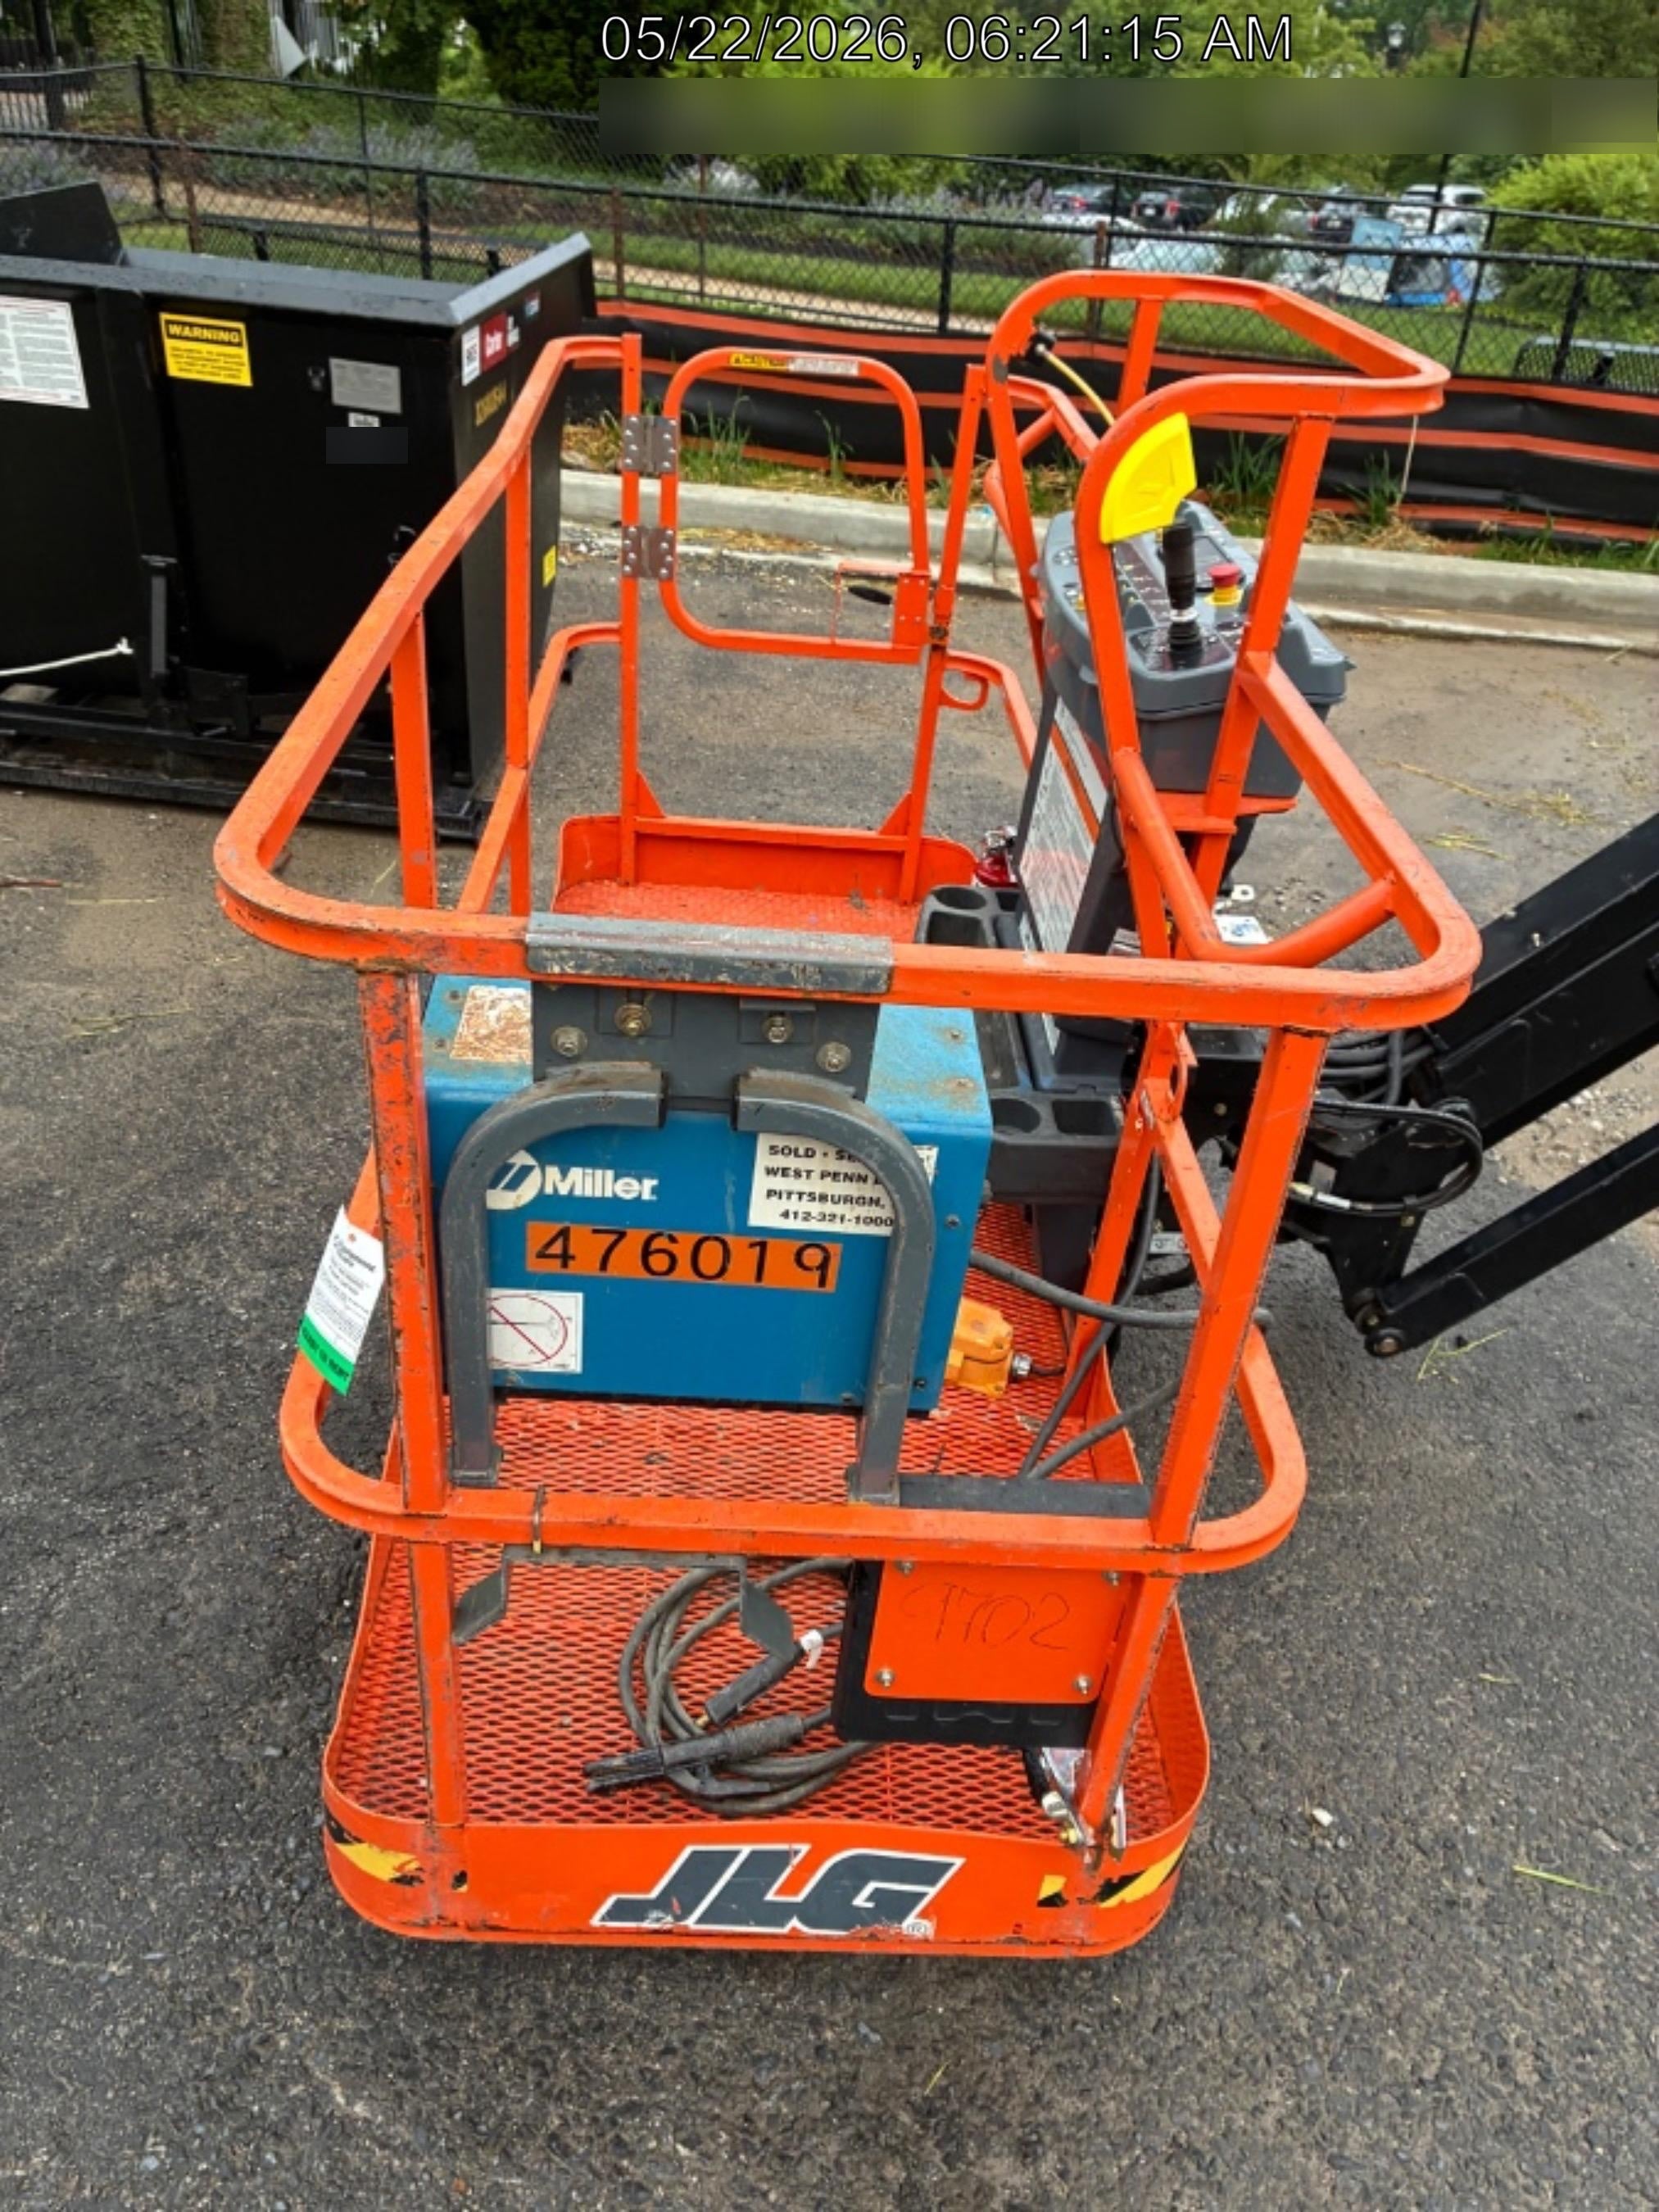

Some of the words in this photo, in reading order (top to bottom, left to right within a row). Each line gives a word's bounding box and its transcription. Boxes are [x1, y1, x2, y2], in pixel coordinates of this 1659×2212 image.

[168, 323, 241, 343] WARNING
[768, 1145, 816, 1159] SOLD
[545, 1164, 660, 1201] Miller
[764, 1167, 814, 1181] WEST
[820, 1170, 868, 1185] PENN
[535, 1226, 832, 1289] 476019
[590, 1843, 968, 1935] JLG
